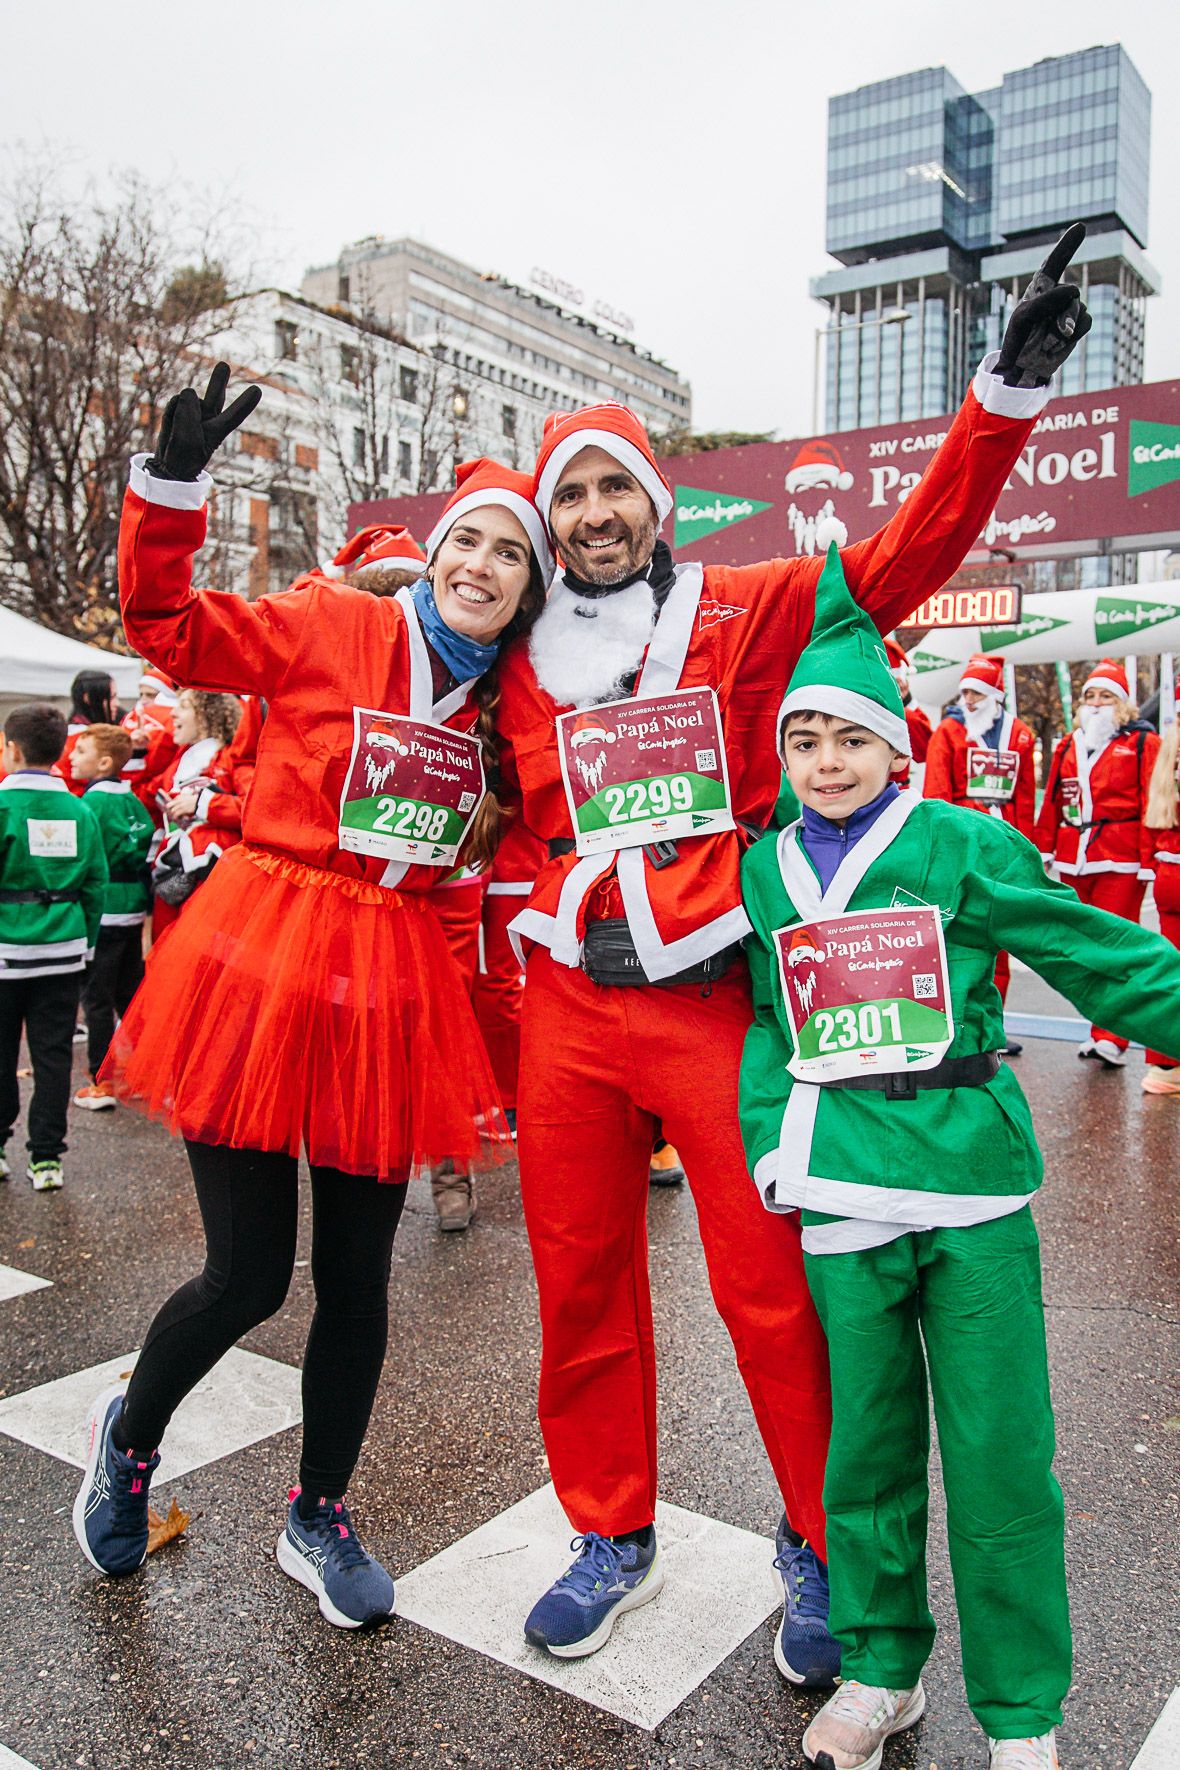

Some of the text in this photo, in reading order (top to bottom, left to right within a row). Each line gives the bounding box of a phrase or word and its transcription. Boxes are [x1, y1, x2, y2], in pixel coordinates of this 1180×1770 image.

[869, 438, 898, 458] XIV
[1030, 411, 1087, 434] DARIA
[1091, 406, 1120, 424] DE
[868, 431, 1118, 508] Pa Noel
[628, 706, 656, 716] CARRERA
[656, 701, 688, 711] SOLIDARIA
[615, 709, 704, 740] Papá Noel
[409, 740, 474, 770] Papá Noel
[423, 733, 442, 743] CARRERA
[442, 739, 462, 750] SOLIDARIA
[604, 776, 694, 824] 2299
[372, 797, 449, 841] 2298
[839, 923, 870, 934] CARRERA
[870, 920, 906, 929] SOLIDARIA
[824, 930, 925, 959] Papá Noel
[814, 1002, 902, 1052] 2301
